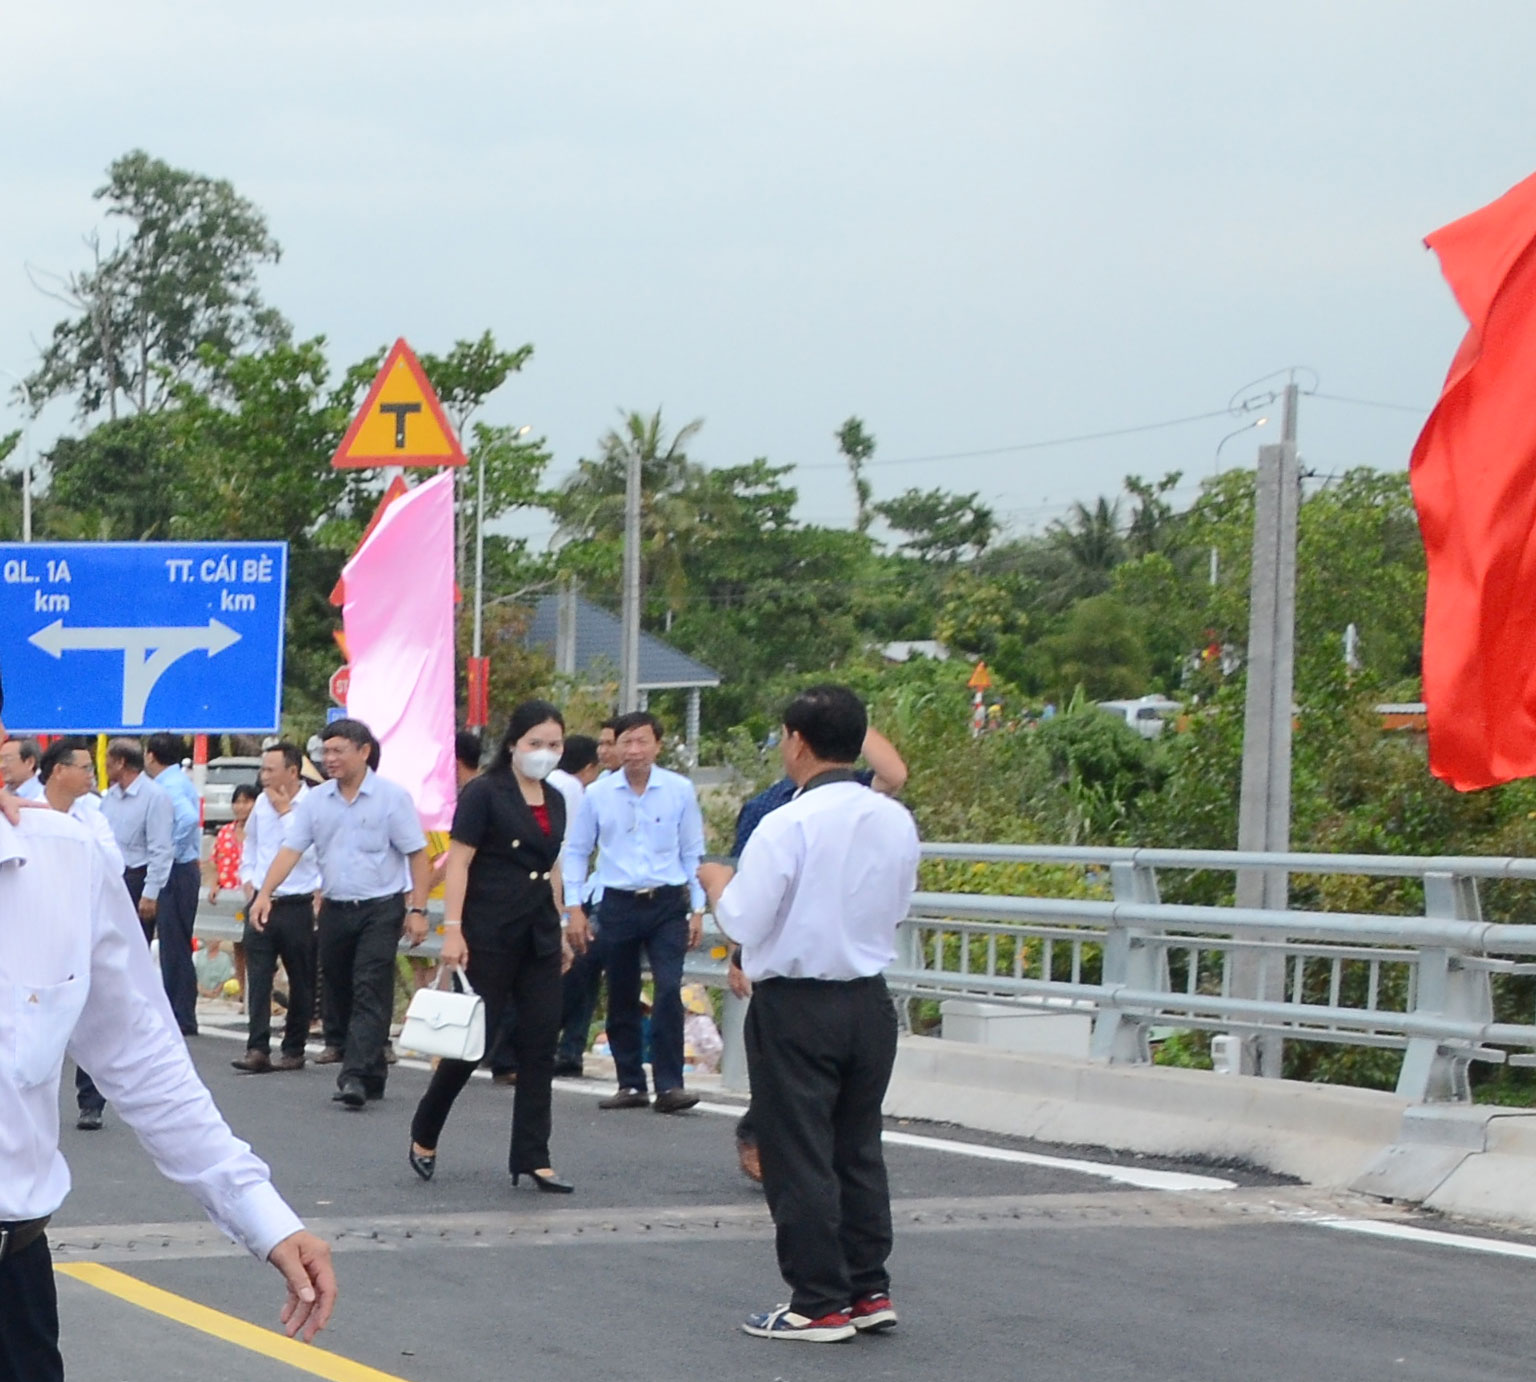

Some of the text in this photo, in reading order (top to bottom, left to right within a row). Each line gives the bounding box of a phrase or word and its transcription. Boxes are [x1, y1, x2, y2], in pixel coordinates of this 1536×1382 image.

[3, 559, 72, 583] QL. 1A
[165, 553, 273, 583] TT. CÁI BÈ
[34, 588, 71, 612] km
[220, 588, 256, 612] km
